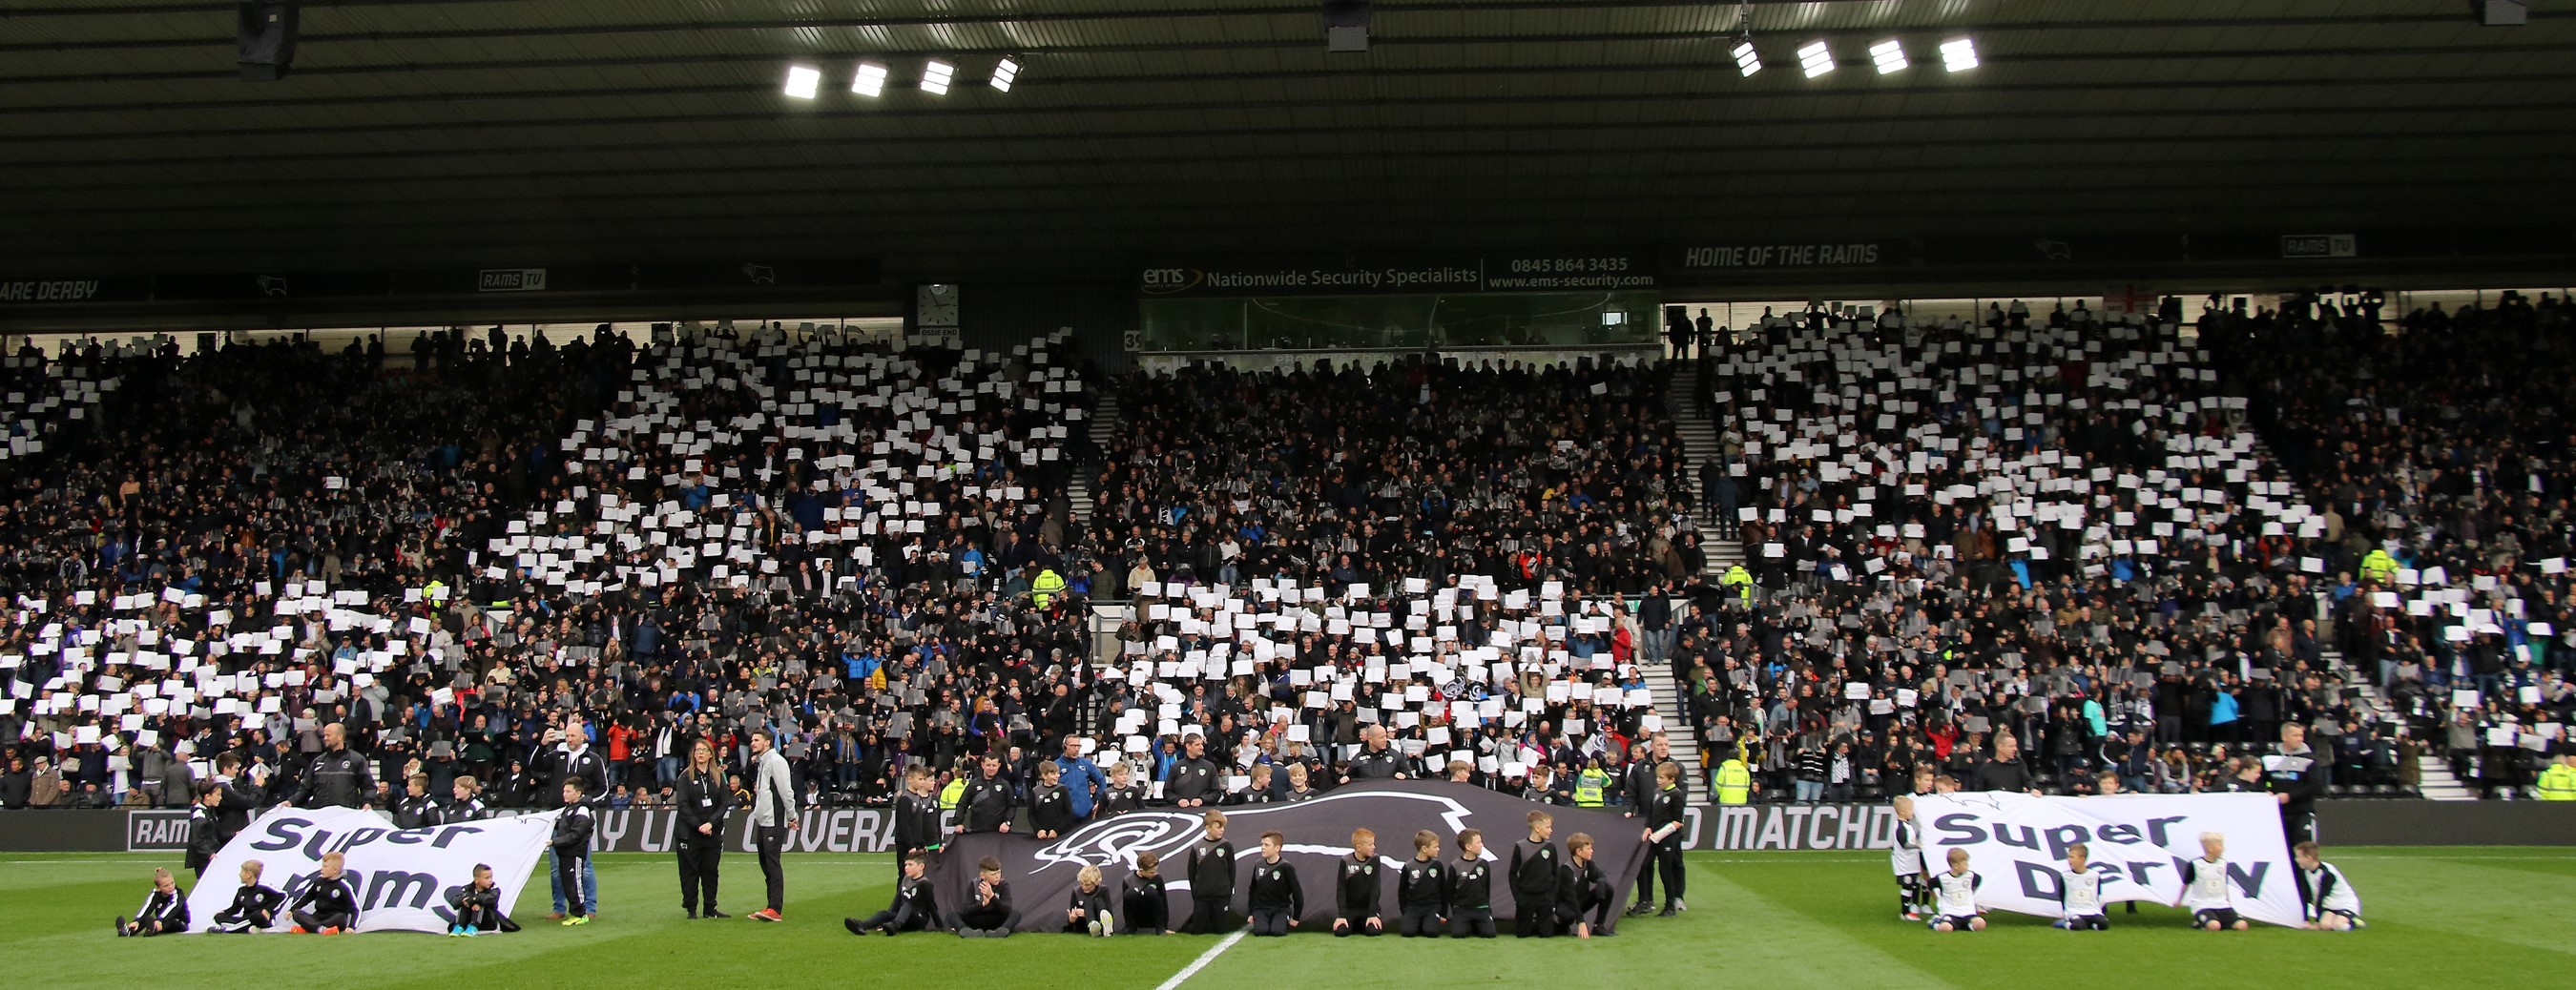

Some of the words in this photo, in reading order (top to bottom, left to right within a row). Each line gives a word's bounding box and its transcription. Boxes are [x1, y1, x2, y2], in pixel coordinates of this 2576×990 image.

[1686, 247, 1745, 267] HOME
[1748, 246, 1775, 266] OF
[1778, 244, 1816, 266] THE
[1818, 243, 1879, 265] RAMS
[2288, 239, 2328, 253] RAMS
[1144, 268, 1185, 284] ems
[1511, 258, 1551, 273] 0845
[1555, 258, 1586, 272] 864
[1589, 257, 1629, 271] 3435
[484, 274, 521, 287] RAMS
[1208, 270, 1307, 288] Nationwide
[1312, 268, 1381, 288] Security
[1386, 266, 1477, 286] Specialists
[1489, 273, 1654, 289] www.ems-security.com
[0, 281, 35, 301] ARE
[36, 279, 99, 300] DERBY
[136, 817, 190, 844] RAM
[250, 817, 485, 861] Super
[1714, 805, 1894, 851] MATCHD
[1934, 813, 2188, 861] Super
[2014, 856, 2271, 901] Dery
